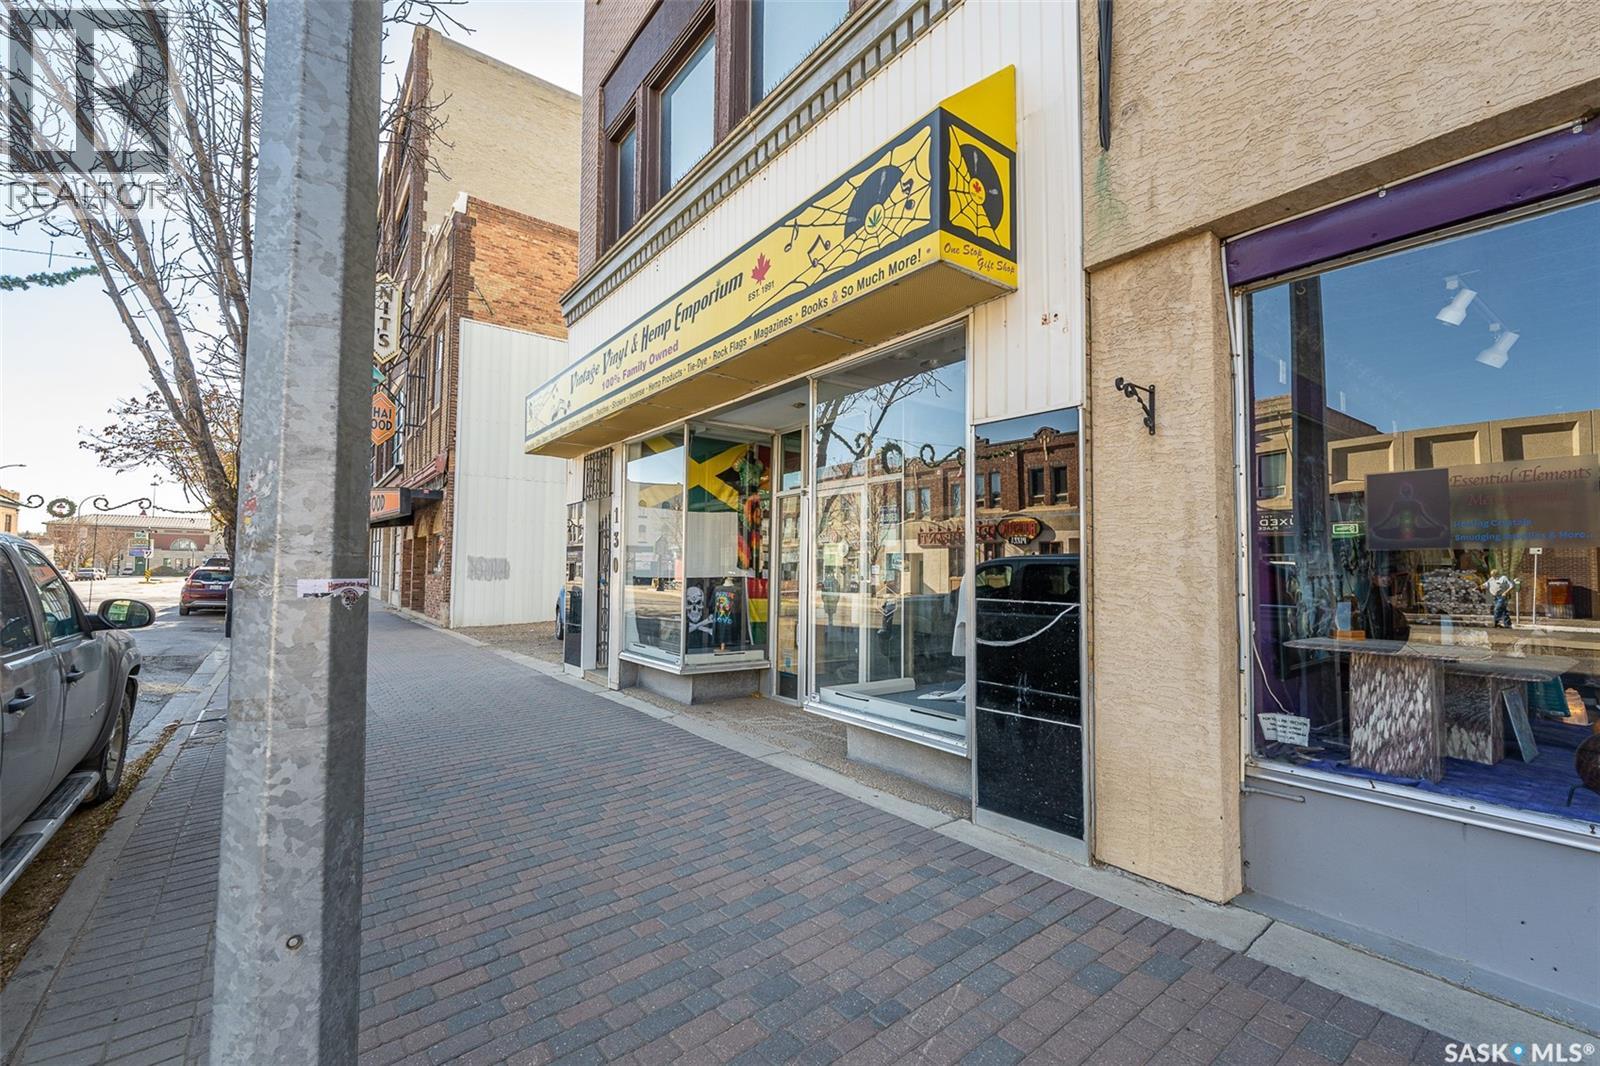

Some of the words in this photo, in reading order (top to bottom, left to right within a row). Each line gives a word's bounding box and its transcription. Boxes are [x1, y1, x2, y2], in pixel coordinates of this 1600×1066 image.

[944, 242, 960, 254] One
[963, 244, 982, 258] Stop
[977, 257, 994, 271] Gift
[996, 260, 1015, 275] Shop
[748, 289, 760, 302] EST.
[761, 280, 775, 295] 1991
[661, 368, 683, 385] Products
[687, 357, 708, 373] Tie-Dye
[712, 345, 729, 361] Rock
[729, 336, 748, 353] Flags
[753, 314, 793, 341] Magazines
[801, 296, 828, 319] Books
[831, 290, 839, 303] &
[841, 286, 854, 299] So
[856, 268, 885, 292] Much
[888, 248, 921, 276] More!
[570, 363, 600, 394] Vintage
[602, 340, 629, 375] Vinyl
[630, 333, 638, 354] &
[641, 318, 671, 350] Hemp
[674, 272, 744, 332] Emporium
[601, 374, 621, 390] 100%
[622, 360, 647, 380] Family
[648, 340, 679, 365] Owned
[373, 407, 392, 419] HAI
[371, 419, 392, 431] OOD
[1450, 466, 1517, 488] Essential
[1519, 465, 1592, 483] Elements
[371, 494, 386, 512] OOD
